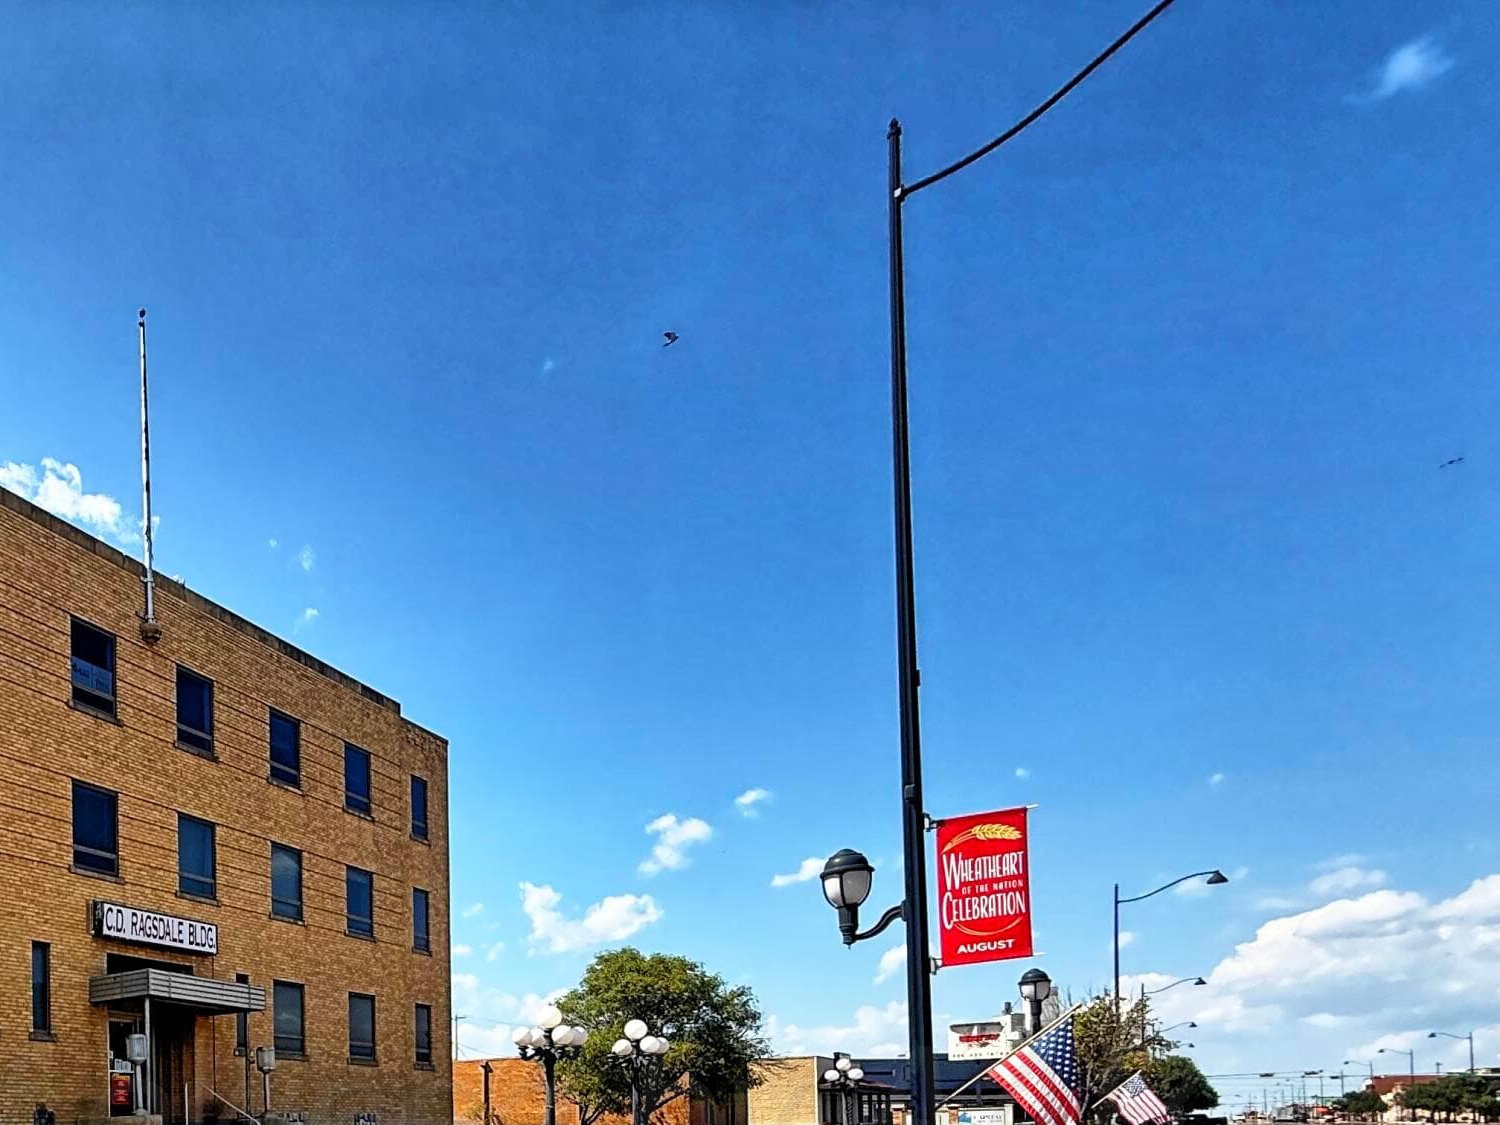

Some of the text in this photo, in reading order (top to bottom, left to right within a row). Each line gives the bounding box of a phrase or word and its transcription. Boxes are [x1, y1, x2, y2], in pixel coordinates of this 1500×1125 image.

[942, 850, 1025, 890] WHEATHEART
[961, 879, 1024, 895] OF THE NATION
[105, 907, 216, 949] C.D. RAGSDALE BLDG.
[942, 891, 1026, 930] CELEBRATION
[957, 938, 1016, 954] AUGUST
